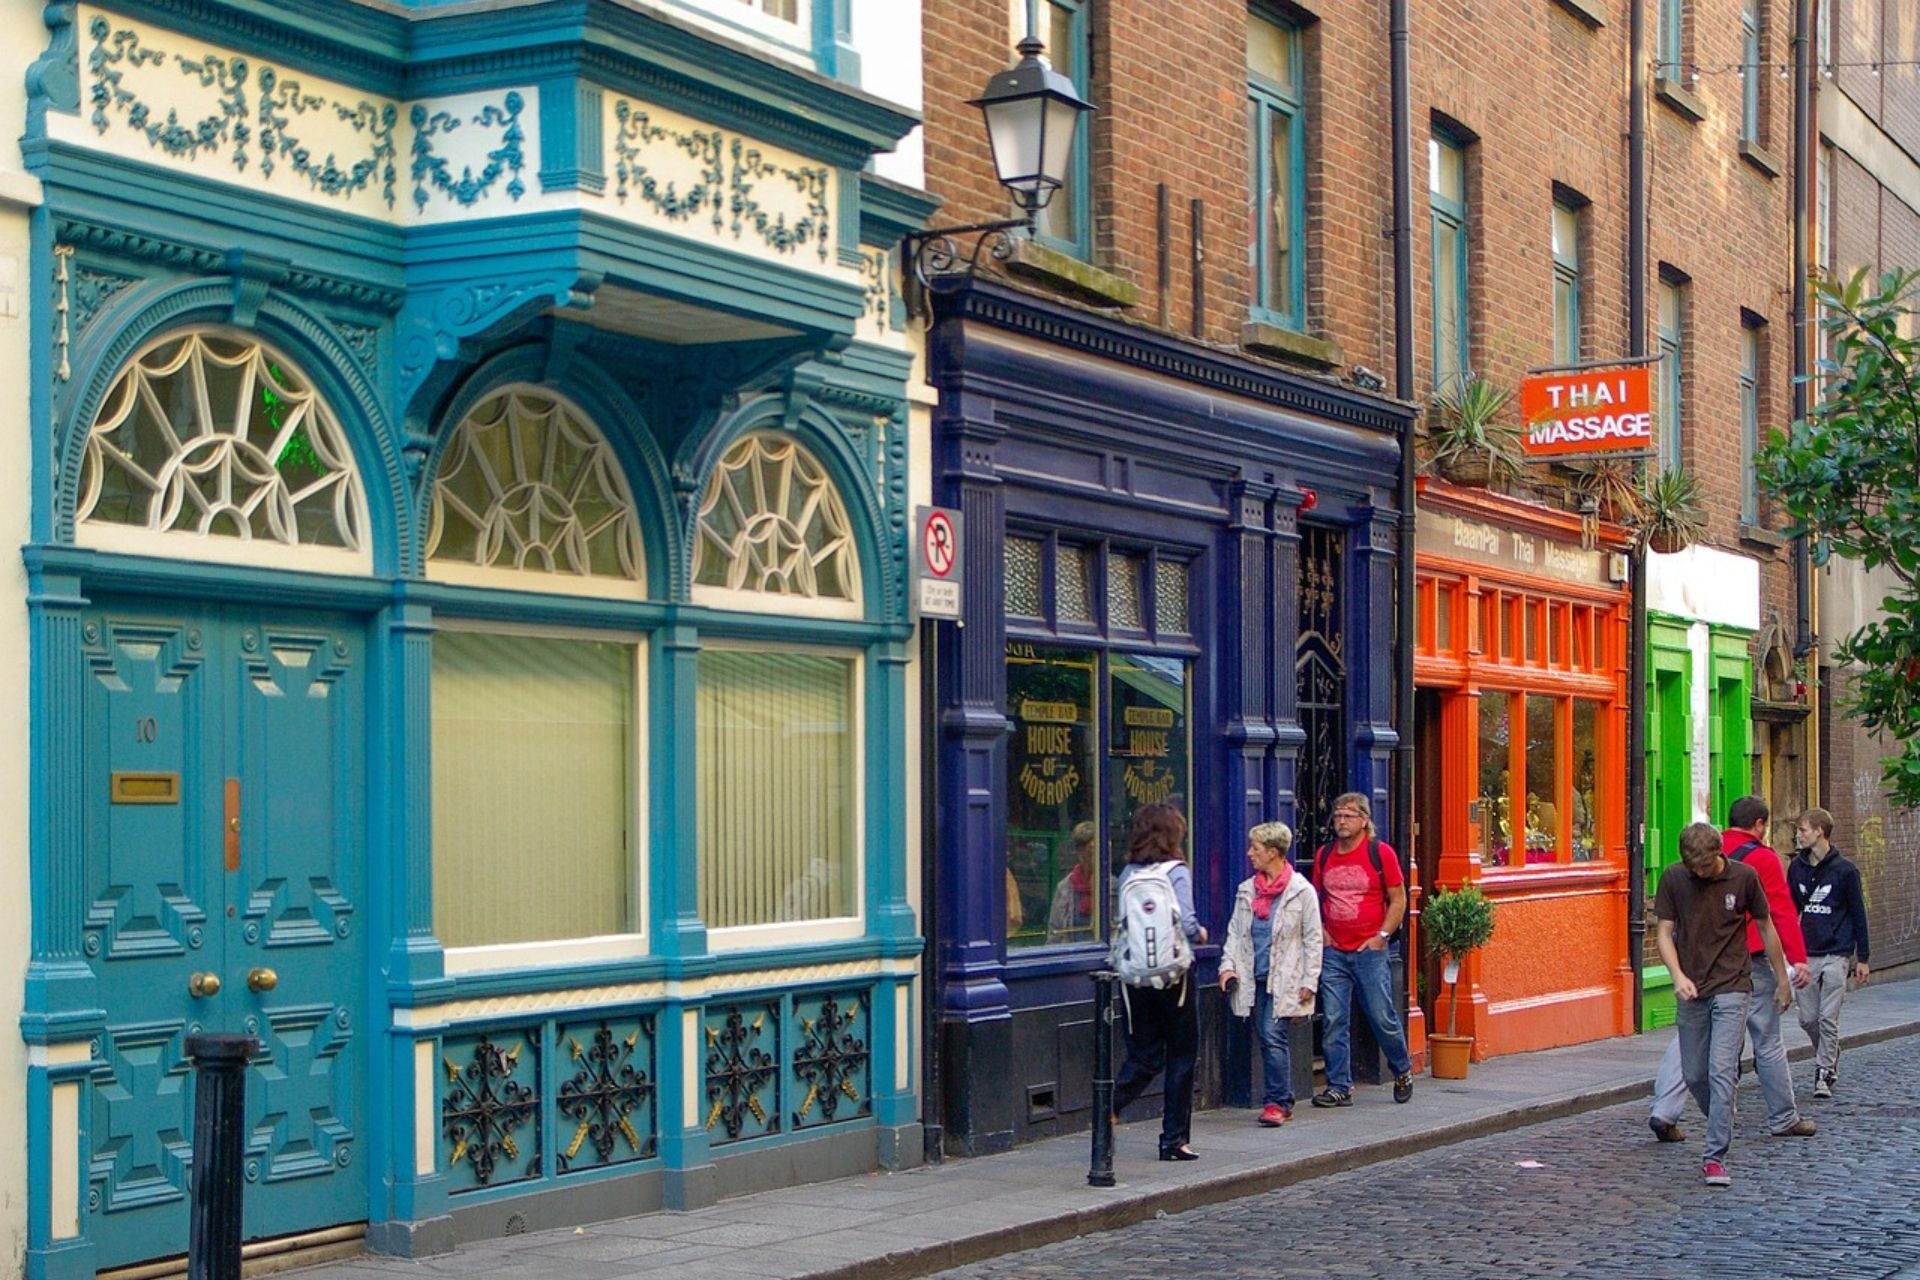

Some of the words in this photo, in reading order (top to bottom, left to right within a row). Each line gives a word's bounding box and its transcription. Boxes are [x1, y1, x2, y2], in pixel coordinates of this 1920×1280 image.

[1546, 380, 1627, 408] THAI
[1529, 413, 1650, 444] MASSAGE
[1454, 518, 1499, 555] BaanPai
[1512, 533, 1535, 563] Thai
[1544, 540, 1588, 579] Massage
[1058, 705, 1075, 720] BAR
[135, 716, 157, 744] 10
[1027, 726, 1072, 755] HOUSE
[1130, 730, 1168, 757] HOUSE
[1042, 758, 1056, 776] OF
[1143, 760, 1154, 777] OF
[1020, 763, 1079, 805] HORRORS
[1123, 764, 1174, 804] HORRORS
